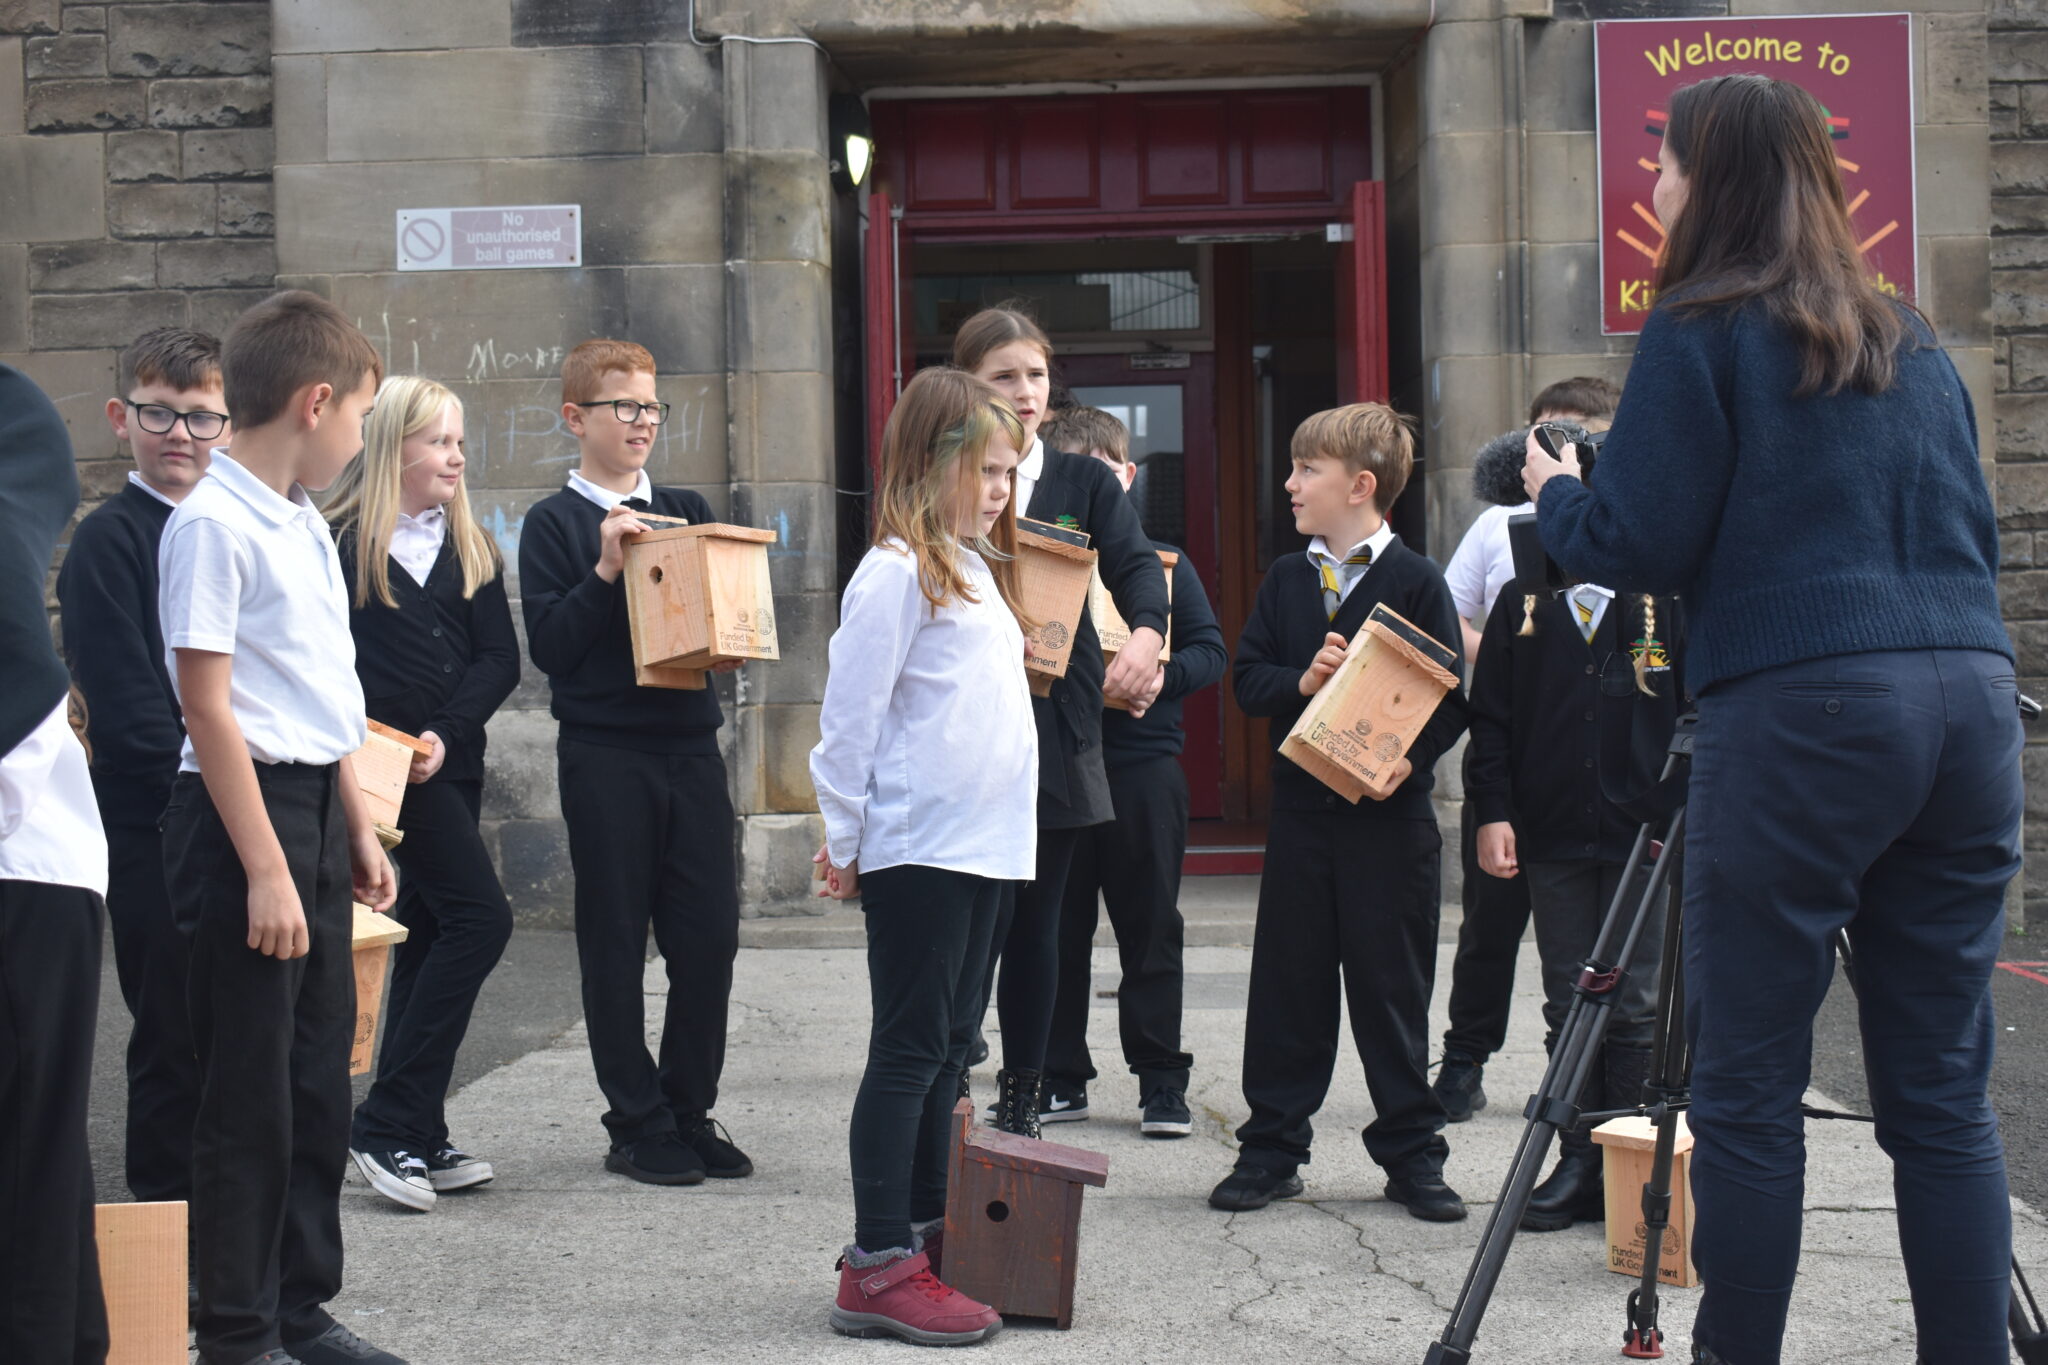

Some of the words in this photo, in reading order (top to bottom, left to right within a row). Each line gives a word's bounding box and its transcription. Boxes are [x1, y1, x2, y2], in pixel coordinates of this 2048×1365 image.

[1644, 31, 1802, 77] Welcome
[1817, 42, 1850, 76] to
[502, 212, 524, 226] No
[467, 227, 561, 243] unauthorised
[475, 247, 501, 261] ball
[506, 248, 554, 263] games
[719, 631, 746, 642] Funded
[1098, 629, 1128, 641] Funded
[720, 641, 732, 651] UK
[732, 642, 772, 653] Government
[1317, 721, 1350, 748] Funded
[1350, 743, 1362, 758] by
[1311, 730, 1328, 746] UK
[1326, 741, 1377, 781] Government
[1611, 1245, 1643, 1261] Funded
[1612, 1255, 1626, 1268] UK
